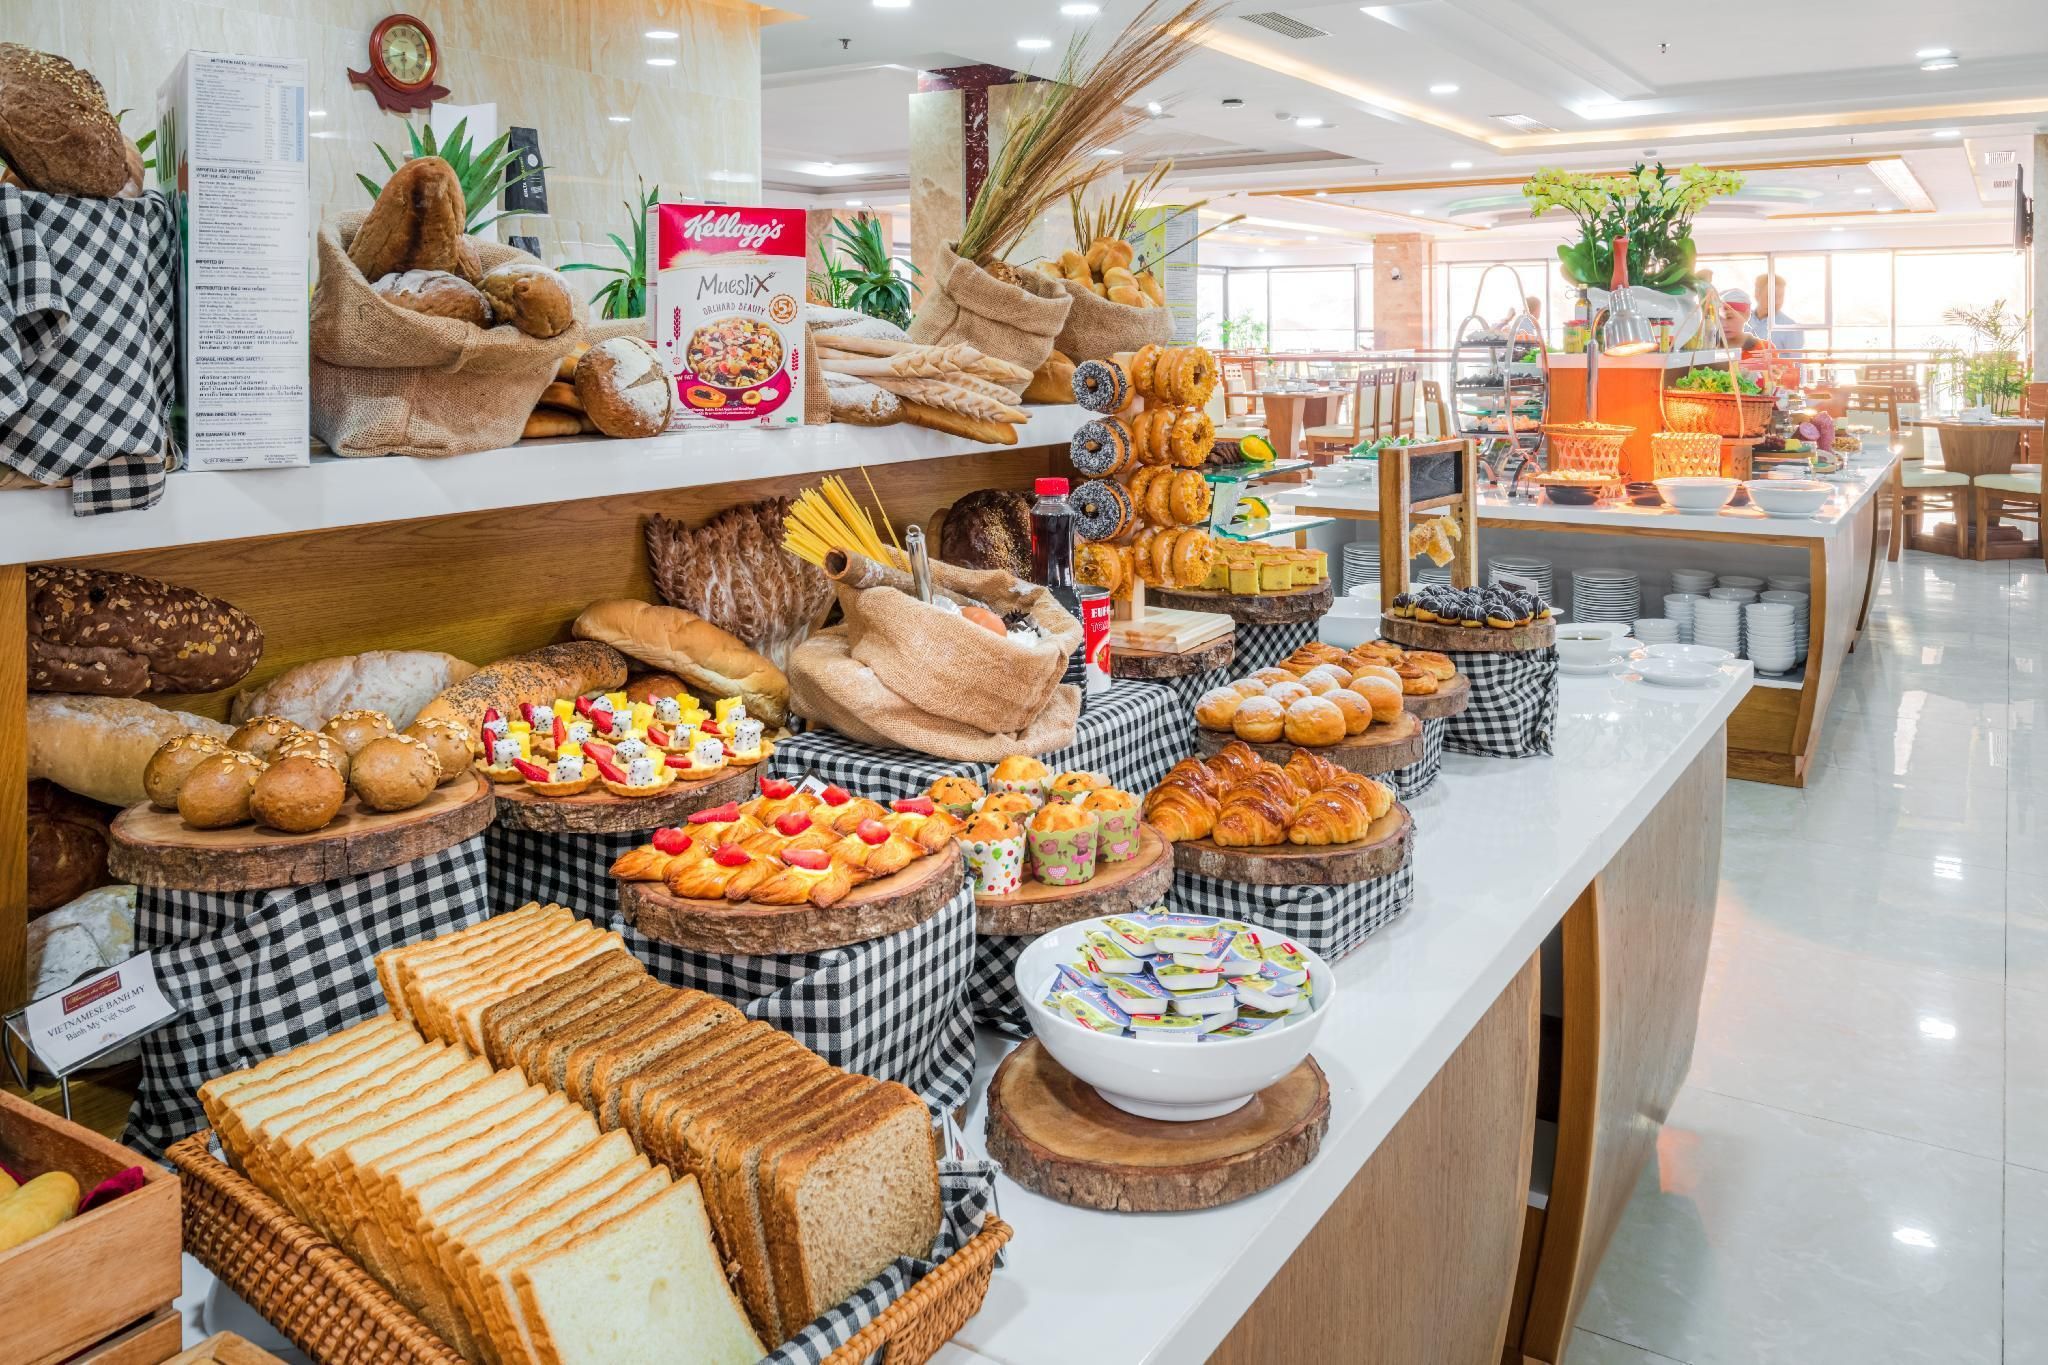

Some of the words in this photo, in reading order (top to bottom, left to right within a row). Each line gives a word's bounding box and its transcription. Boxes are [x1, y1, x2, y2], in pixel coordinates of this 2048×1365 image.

[683, 209, 785, 249] Kellogg's
[697, 272, 776, 300] MuesliX
[702, 302, 736, 316] ORCHARD
[738, 302, 766, 316] BEAUTY
[777, 300, 788, 316] 5
[47, 1005, 105, 1037] VIETNAMESE
[132, 984, 145, 996] MY
[118, 1004, 136, 1014] Nam
